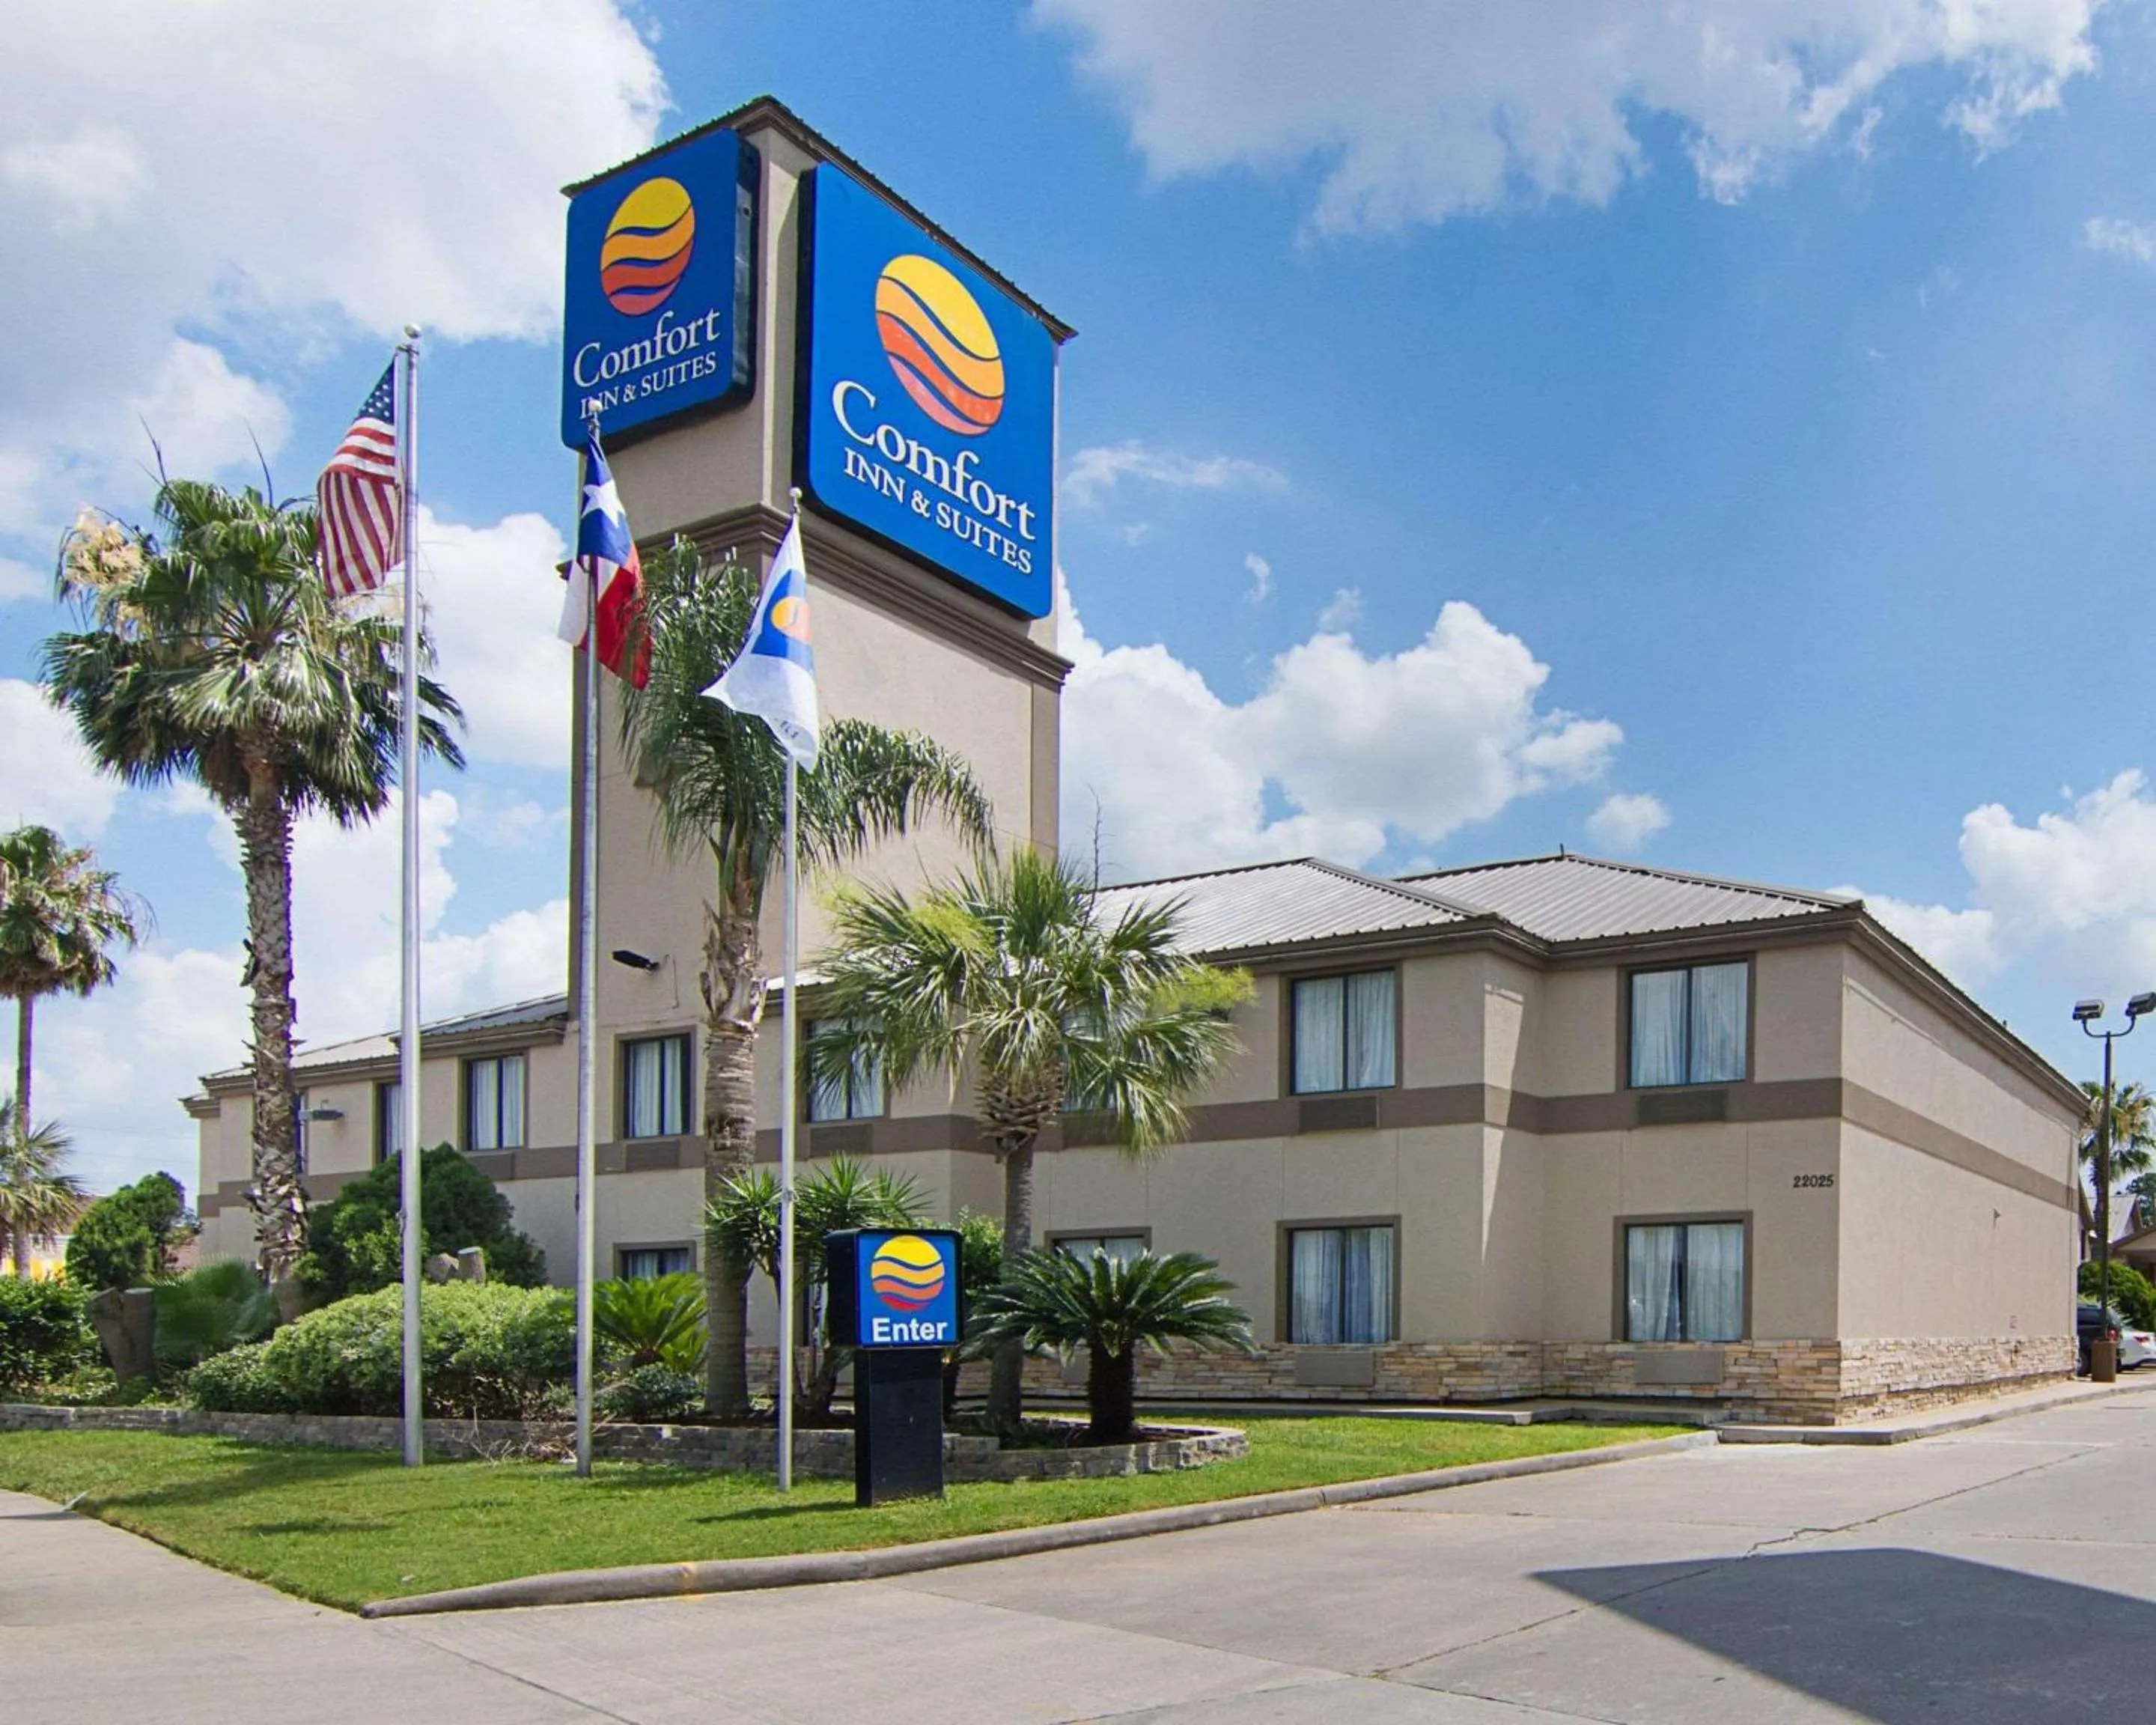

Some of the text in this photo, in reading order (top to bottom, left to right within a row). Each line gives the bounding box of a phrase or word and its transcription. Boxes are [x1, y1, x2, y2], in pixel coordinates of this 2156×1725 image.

[573, 308, 720, 387] Comfort
[623, 383, 636, 403] &
[641, 351, 716, 397] SUITES
[832, 380, 1035, 540] Comfort
[844, 447, 1032, 574] INN & SUITES
[1793, 1174, 1834, 1188] 22025
[872, 1317, 948, 1342] Enter
